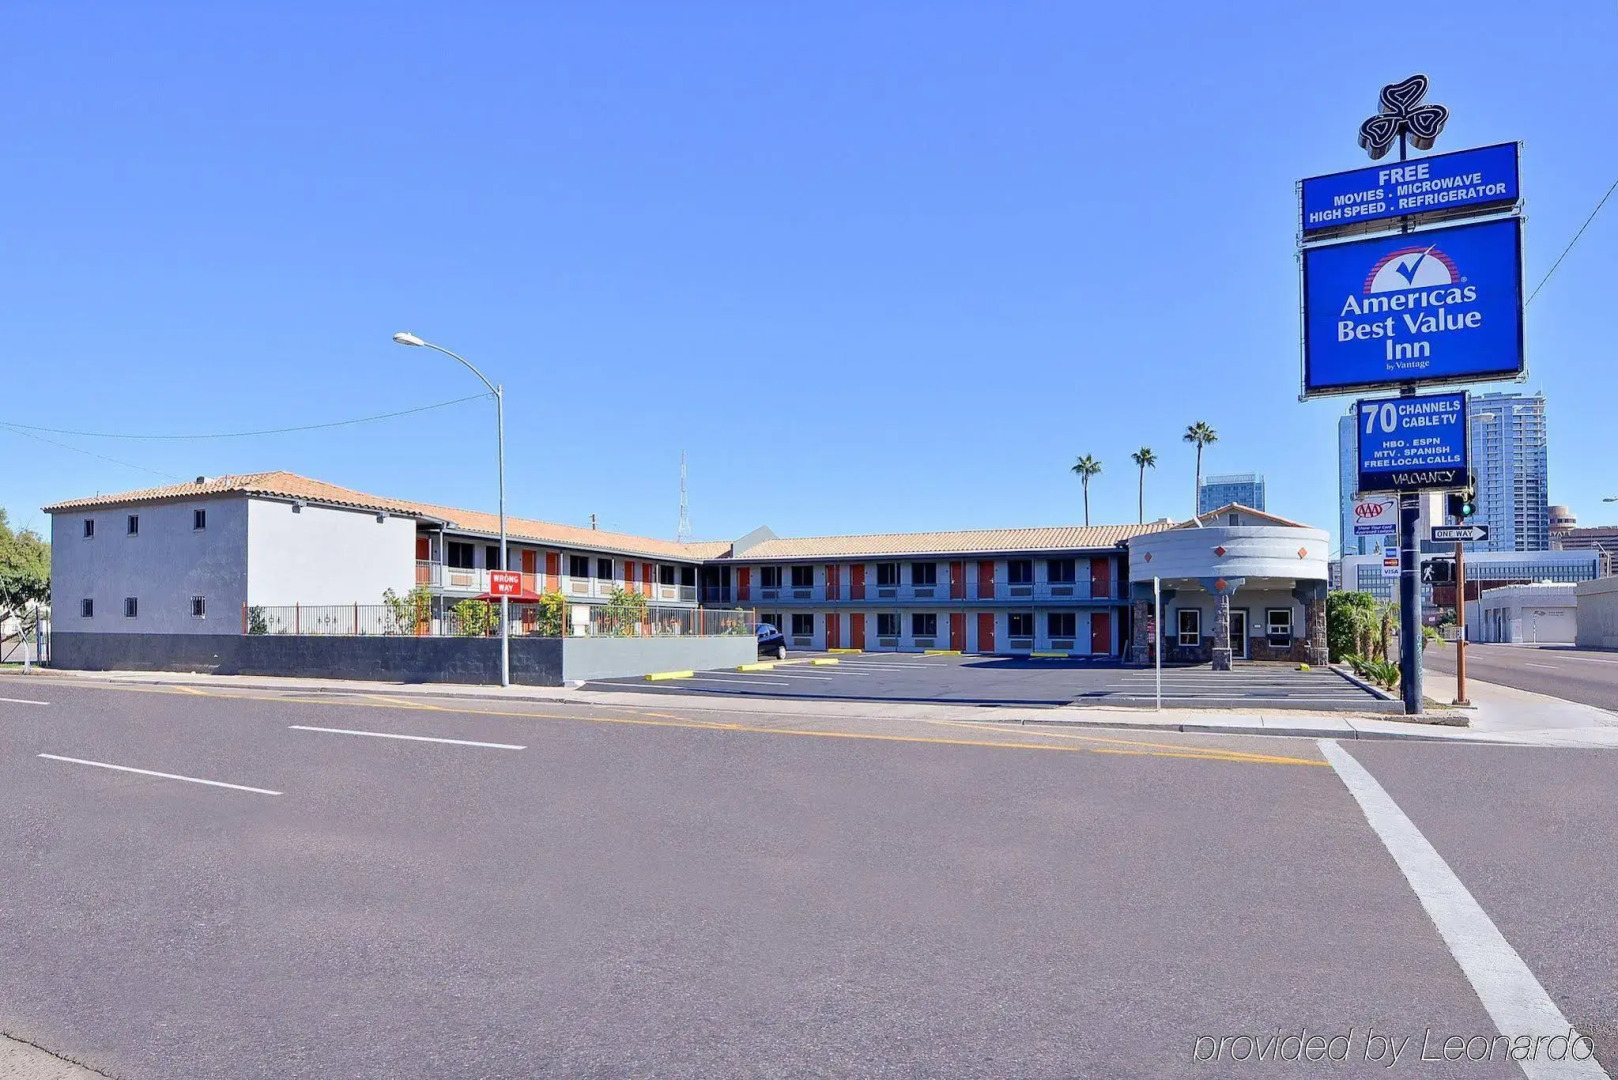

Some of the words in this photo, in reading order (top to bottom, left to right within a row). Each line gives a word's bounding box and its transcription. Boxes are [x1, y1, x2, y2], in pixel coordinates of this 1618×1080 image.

[1379, 163, 1430, 186] FREE
[1334, 189, 1384, 207] MOVIES
[1397, 172, 1482, 196] MICROWAVE
[1309, 205, 1342, 224] HIGH
[1344, 201, 1386, 218] SPEED
[1398, 182, 1507, 210] REFRIGERATOR
[1340, 285, 1478, 317] Americas
[1337, 317, 1396, 342] Best
[1403, 307, 1482, 334] Value
[1386, 339, 1431, 361] Inn
[1386, 362, 1395, 371] by
[1396, 359, 1430, 370] Vantage
[1398, 400, 1461, 416] CHANNELS
[1361, 403, 1398, 434] 70
[1402, 415, 1440, 428] CABLE
[1440, 413, 1457, 425] TV
[1382, 440, 1405, 449] HBO
[1412, 437, 1441, 447] ESPN
[1374, 449, 1396, 458] MTV
[1404, 446, 1450, 456] SPANISH
[1364, 459, 1390, 468] FREE
[1391, 457, 1426, 467] LOCAL
[1426, 454, 1461, 464] CALLS
[1392, 470, 1456, 485] VACANCY
[1357, 503, 1381, 518] AAA
[493, 574, 519, 584] WRONG
[498, 584, 513, 592] WAY
